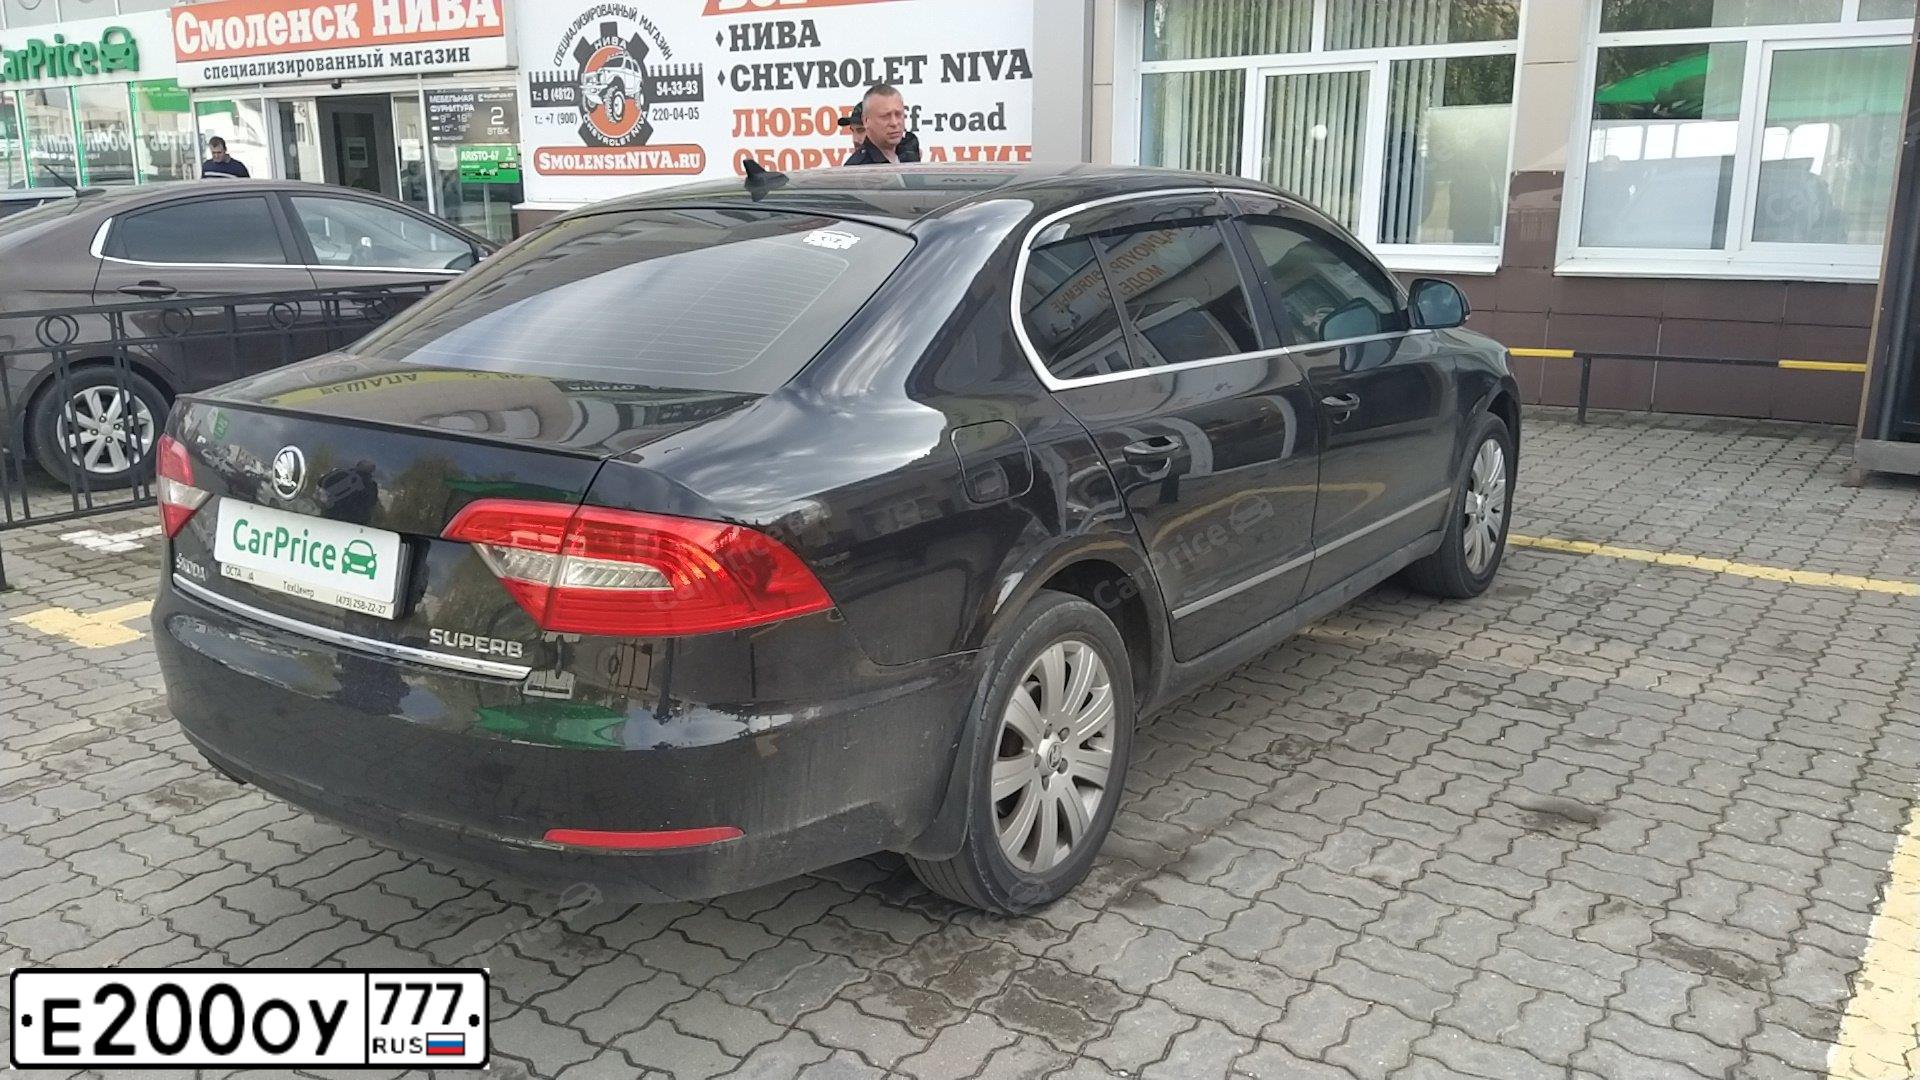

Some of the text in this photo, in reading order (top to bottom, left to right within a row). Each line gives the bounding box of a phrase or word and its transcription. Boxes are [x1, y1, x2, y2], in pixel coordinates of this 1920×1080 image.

[175, 0, 501, 54] Смоленск НИВА
[554, 3, 673, 67] СПЕЦИАЛИЗИРОВАННЫЙ МАГАЗИН
[593, 36, 628, 50] НИВА
[729, 19, 821, 52] НИВА
[0, 34, 99, 83] arPrice
[203, 46, 471, 80] специализированный магазин
[730, 48, 1033, 92] CHEVROLET NIVA
[543, 88, 549, 101] 8
[550, 87, 575, 102] (4812)
[656, 80, 699, 97] 54-33-93
[490, 106, 505, 125] 2
[545, 112, 554, 124] +7
[557, 112, 578, 125] (900)
[652, 108, 700, 121] 220-04-05
[583, 110, 649, 147] CHEVROLET NIVA
[461, 150, 499, 161] ARISTO-67
[232, 518, 337, 571] CarPrice
[429, 628, 523, 659] SUPERB
